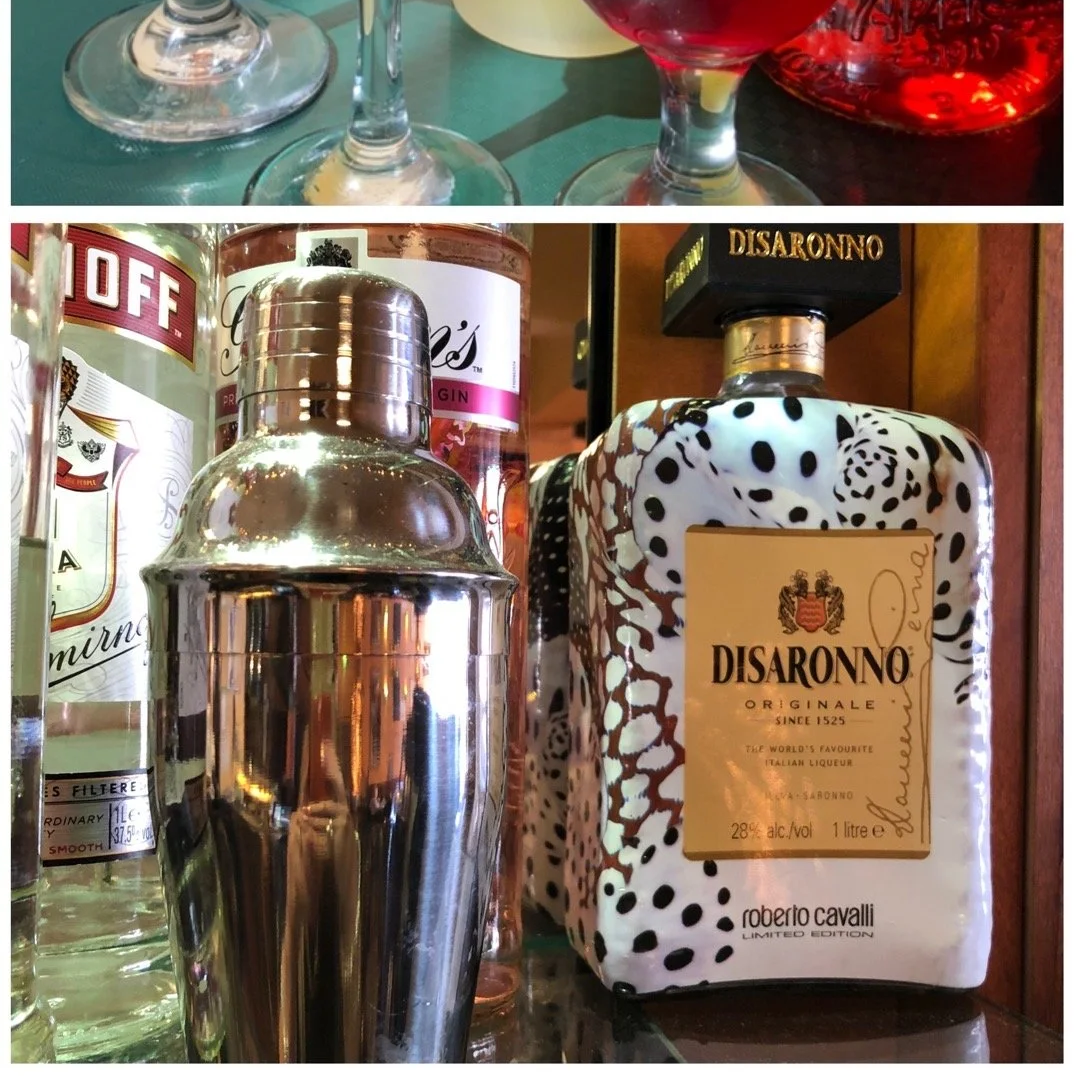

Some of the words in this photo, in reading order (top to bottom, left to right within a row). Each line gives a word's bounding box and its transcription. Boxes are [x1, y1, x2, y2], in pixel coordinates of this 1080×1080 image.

[728, 228, 884, 261] DISARONNO
[437, 388, 469, 403] GIN
[711, 644, 910, 689] DISARONNO
[745, 699, 876, 711] ORIGINALE
[775, 716, 811, 726] SINCE
[816, 715, 846, 726] 1525
[745, 745, 763, 753] THE
[769, 744, 815, 753] WORLD'S
[819, 744, 874, 753] FAVOURITE
[765, 759, 804, 767] ITALIAN
[809, 759, 853, 767] LIQUEUR
[72, 781, 139, 797] FILTERE
[802, 791, 854, 800] SARONNO
[832, 822, 838, 839] 1
[843, 821, 868, 839] litre
[49, 843, 103, 855] SMOOTH
[742, 904, 809, 928] roberto
[814, 903, 874, 928] cavalli
[742, 930, 805, 940] LIMITED
[811, 930, 874, 939] EDITION
